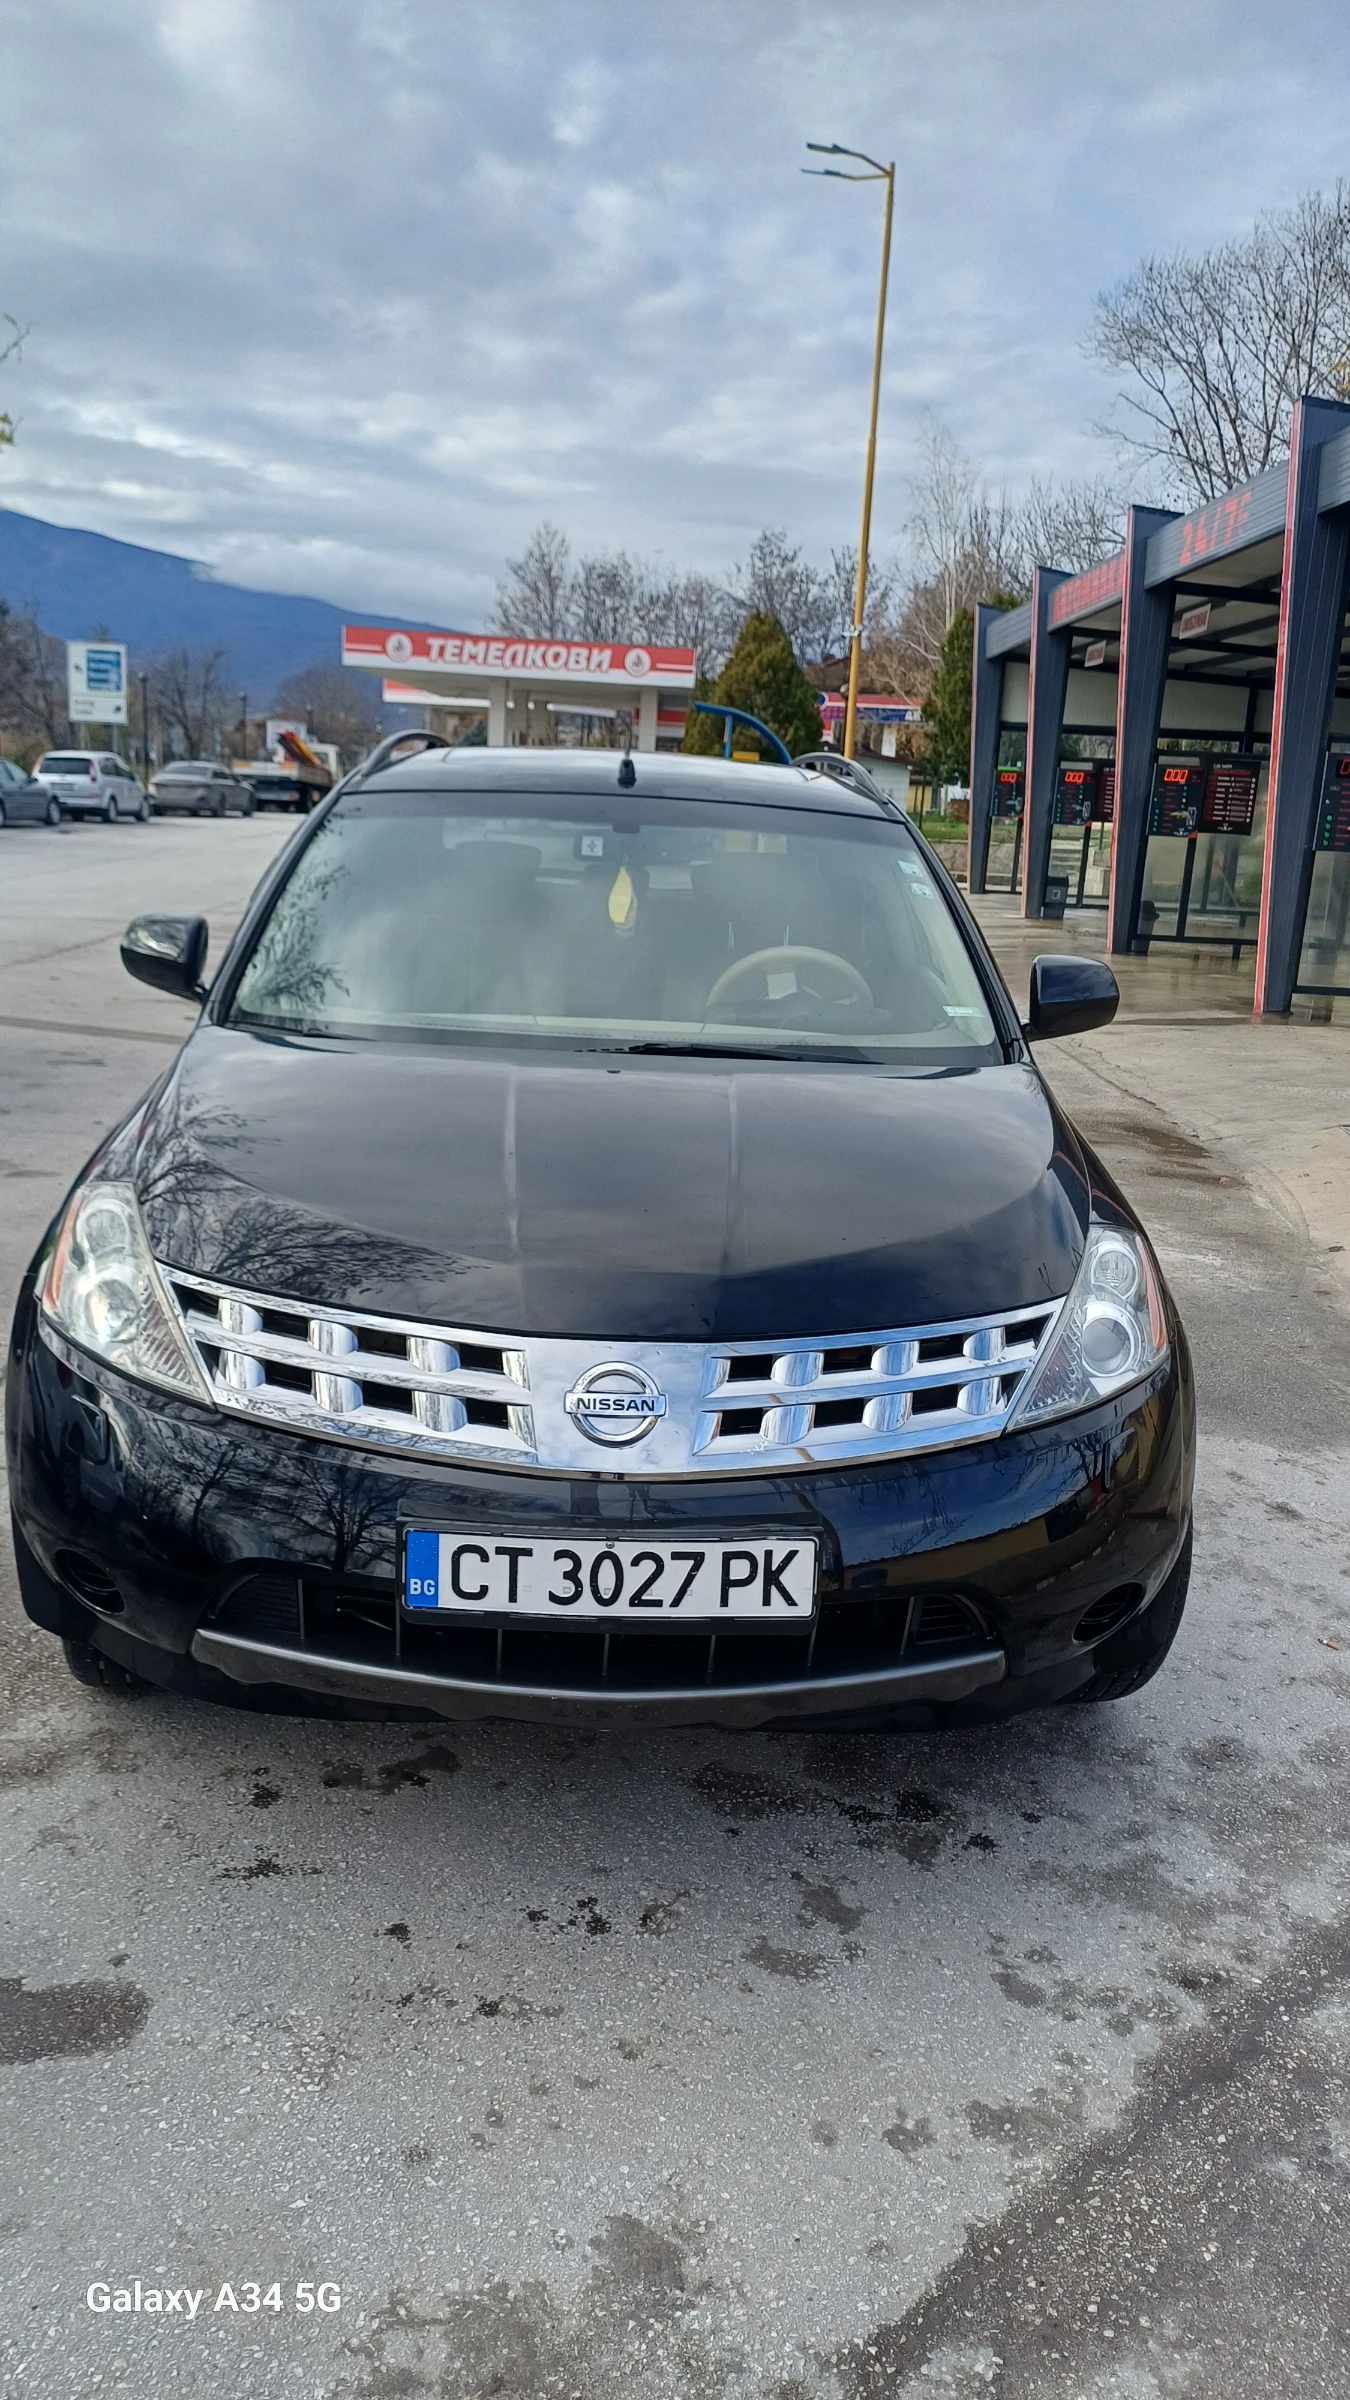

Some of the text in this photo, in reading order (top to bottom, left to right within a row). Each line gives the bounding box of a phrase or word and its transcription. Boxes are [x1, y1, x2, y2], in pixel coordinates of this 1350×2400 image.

[426, 637, 612, 672] ТЕМЕЛКОВИ
[1164, 769, 1188, 781] 000
[577, 1398, 655, 1411] NISSAN
[451, 1544, 799, 1607] CT 3027 PK
[410, 1578, 435, 1596] BG
